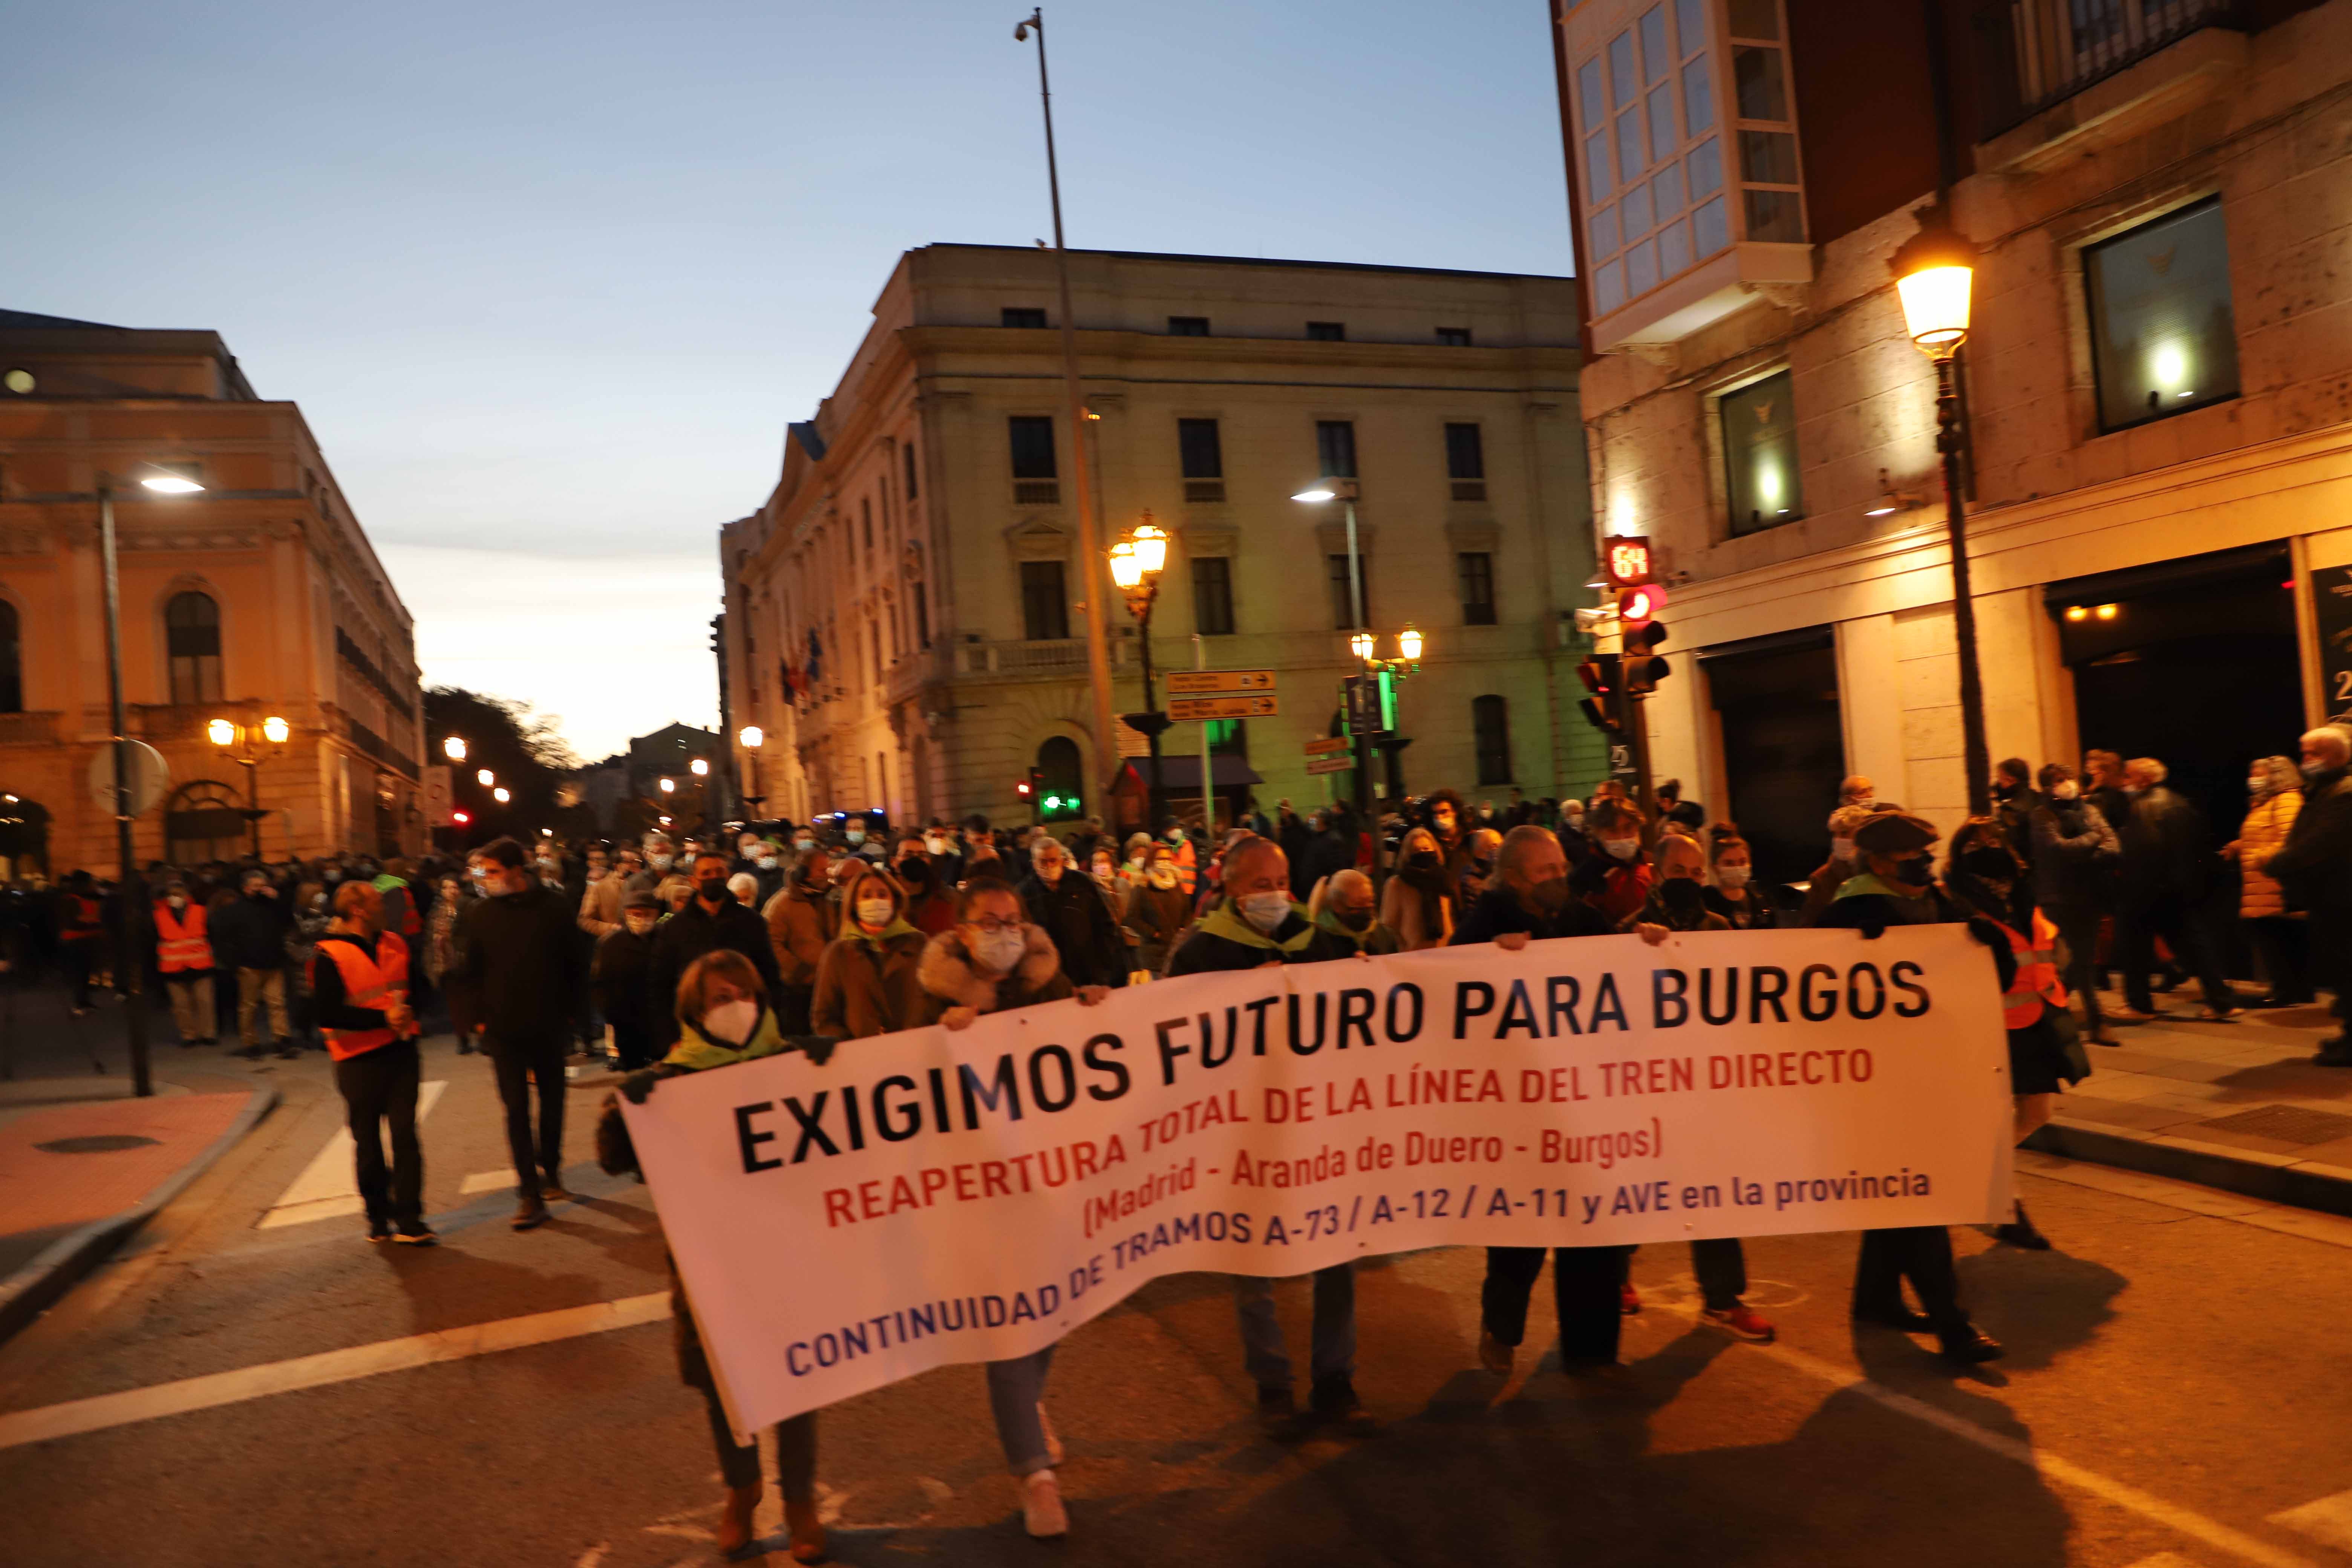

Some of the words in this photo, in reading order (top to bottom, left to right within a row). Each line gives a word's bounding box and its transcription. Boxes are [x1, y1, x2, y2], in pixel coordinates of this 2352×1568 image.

[1612, 547, 1648, 577] 64
[733, 1032, 1131, 1174] EXIGIMOS
[1155, 982, 1425, 1086] FUTURO
[1453, 973, 1630, 1040] PARA
[1652, 961, 1931, 1028] BURGOS
[823, 1134, 1127, 1228] REAPERTURA
[1139, 1090, 1250, 1152] TOTAL
[1263, 1087, 1313, 1124] DE
[1327, 1078, 1373, 1116] LA
[1387, 1063, 1505, 1107] LÍNEA
[1520, 1067, 1588, 1103] DEL
[1599, 1057, 1693, 1096] TREN
[1710, 1049, 1873, 1089] DIRECTO
[1084, 1158, 1197, 1238] (Madrid
[1231, 1148, 1346, 1188] Aranda
[1357, 1137, 1393, 1172] de
[1405, 1132, 1502, 1166] Duero
[1540, 1117, 1661, 1169] Burgos)
[785, 1285, 1060, 1377] CONTINUIDAD
[1070, 1255, 1102, 1300] DE
[1113, 1212, 1251, 1268] TRAMOS
[1263, 1205, 1338, 1245] A-73
[1348, 1196, 1361, 1231] /
[1371, 1189, 1449, 1224] A-12
[1461, 1185, 1477, 1218] /
[1487, 1188, 1567, 1217] A-11
[1582, 1196, 1601, 1224] y
[1612, 1181, 1670, 1215] AVE
[1681, 1185, 1721, 1208] en
[1732, 1177, 1763, 1205] la
[1775, 1168, 1931, 1208] provincia
